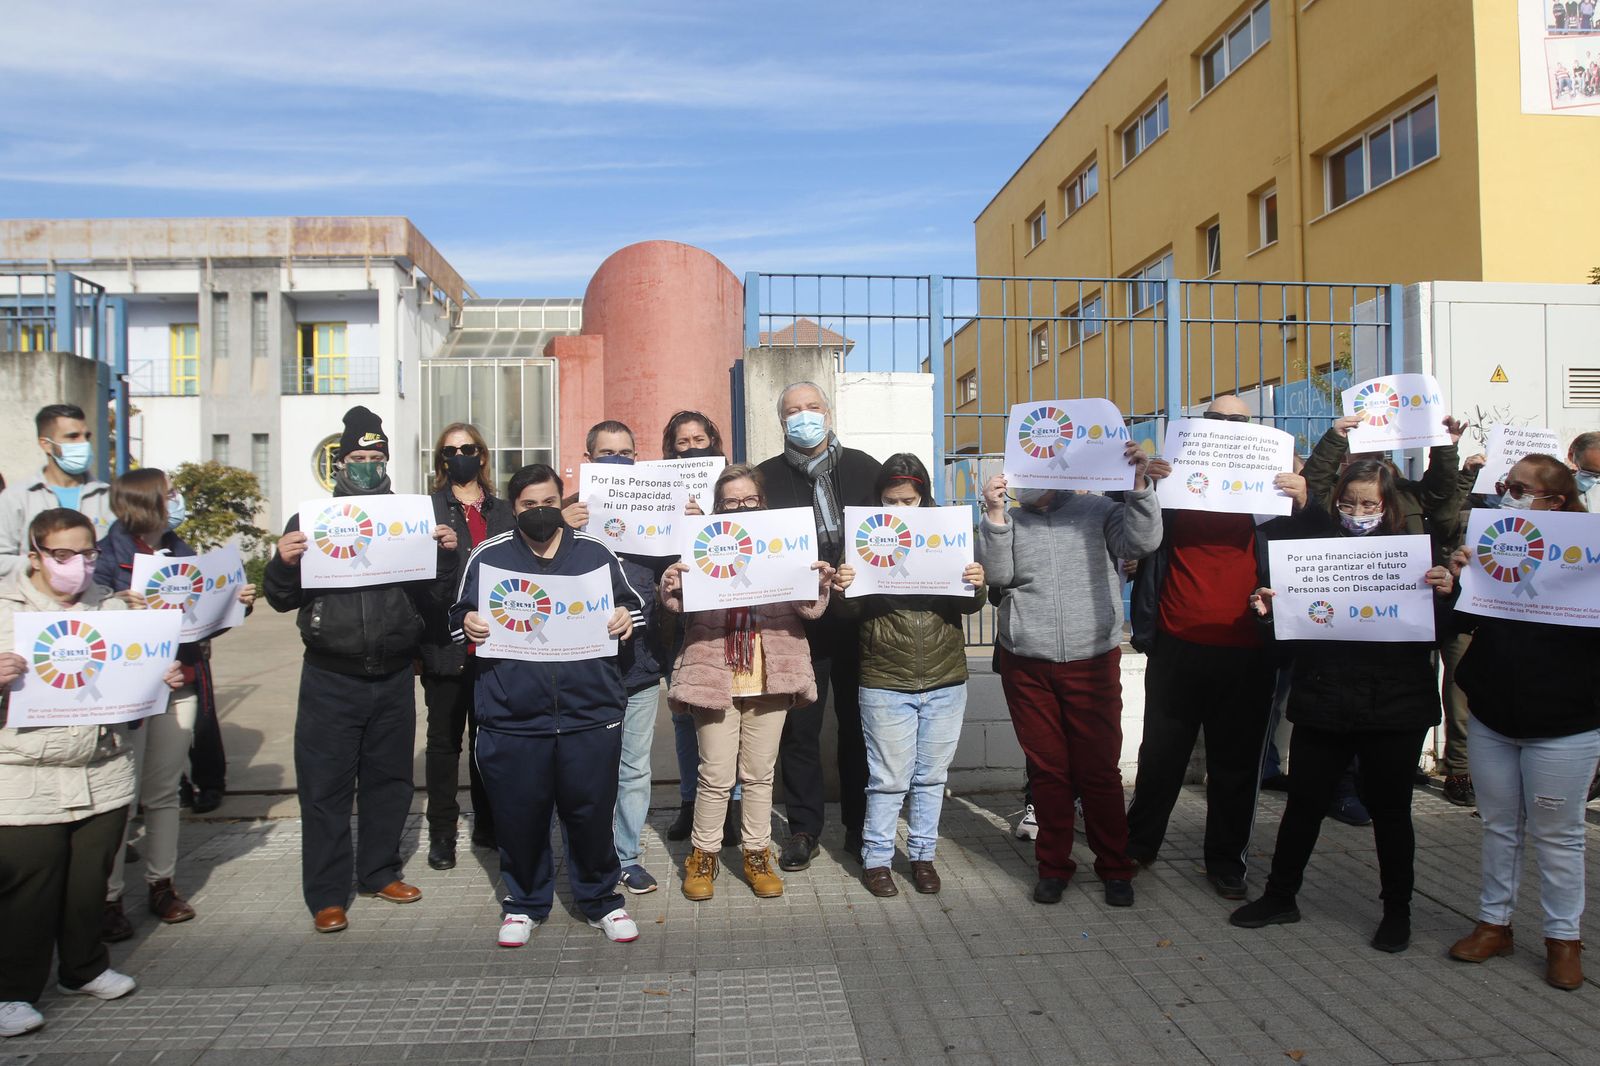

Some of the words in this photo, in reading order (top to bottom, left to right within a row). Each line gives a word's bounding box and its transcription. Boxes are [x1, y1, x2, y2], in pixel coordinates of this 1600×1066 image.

[364, 432, 381, 441] NIKE
[1503, 428, 1517, 436] Por
[1259, 437, 1279, 446] justa
[1526, 440, 1551, 449] Centros
[1198, 449, 1210, 457] los
[1212, 450, 1244, 459] Centros
[1252, 444, 1277, 454] futuro
[1502, 448, 1513, 456] las
[1173, 457, 1210, 466] Personas
[1228, 461, 1283, 471] Discapacidad
[591, 475, 608, 484] Por
[611, 476, 625, 485] las
[629, 477, 671, 487] Personas
[680, 471, 695, 480] tros
[1222, 479, 1264, 492] DOWN
[608, 488, 672, 500] Discapacidad,
[603, 501, 613, 509] ni
[630, 503, 654, 512] paso
[376, 519, 429, 537] DOWN
[637, 524, 672, 536] DOWN
[756, 534, 809, 555] DOWN
[915, 532, 966, 548] DOWN
[1325, 551, 1382, 560] financiación
[1384, 550, 1408, 560] justa
[1548, 543, 1600, 564] DOW
[1295, 565, 1315, 573] para
[1317, 563, 1364, 573] garantizar
[1366, 562, 1375, 570] el
[1377, 561, 1407, 569] futuro
[1302, 575, 1314, 583] de
[1316, 574, 1330, 582] los
[1332, 573, 1370, 582] Centros
[1371, 572, 1384, 580] de
[1386, 572, 1400, 580] las
[1353, 582, 1417, 592] Discapacidad
[555, 593, 609, 615] DOWN
[1349, 604, 1398, 618] DOWN
[111, 640, 171, 661] DOWN
